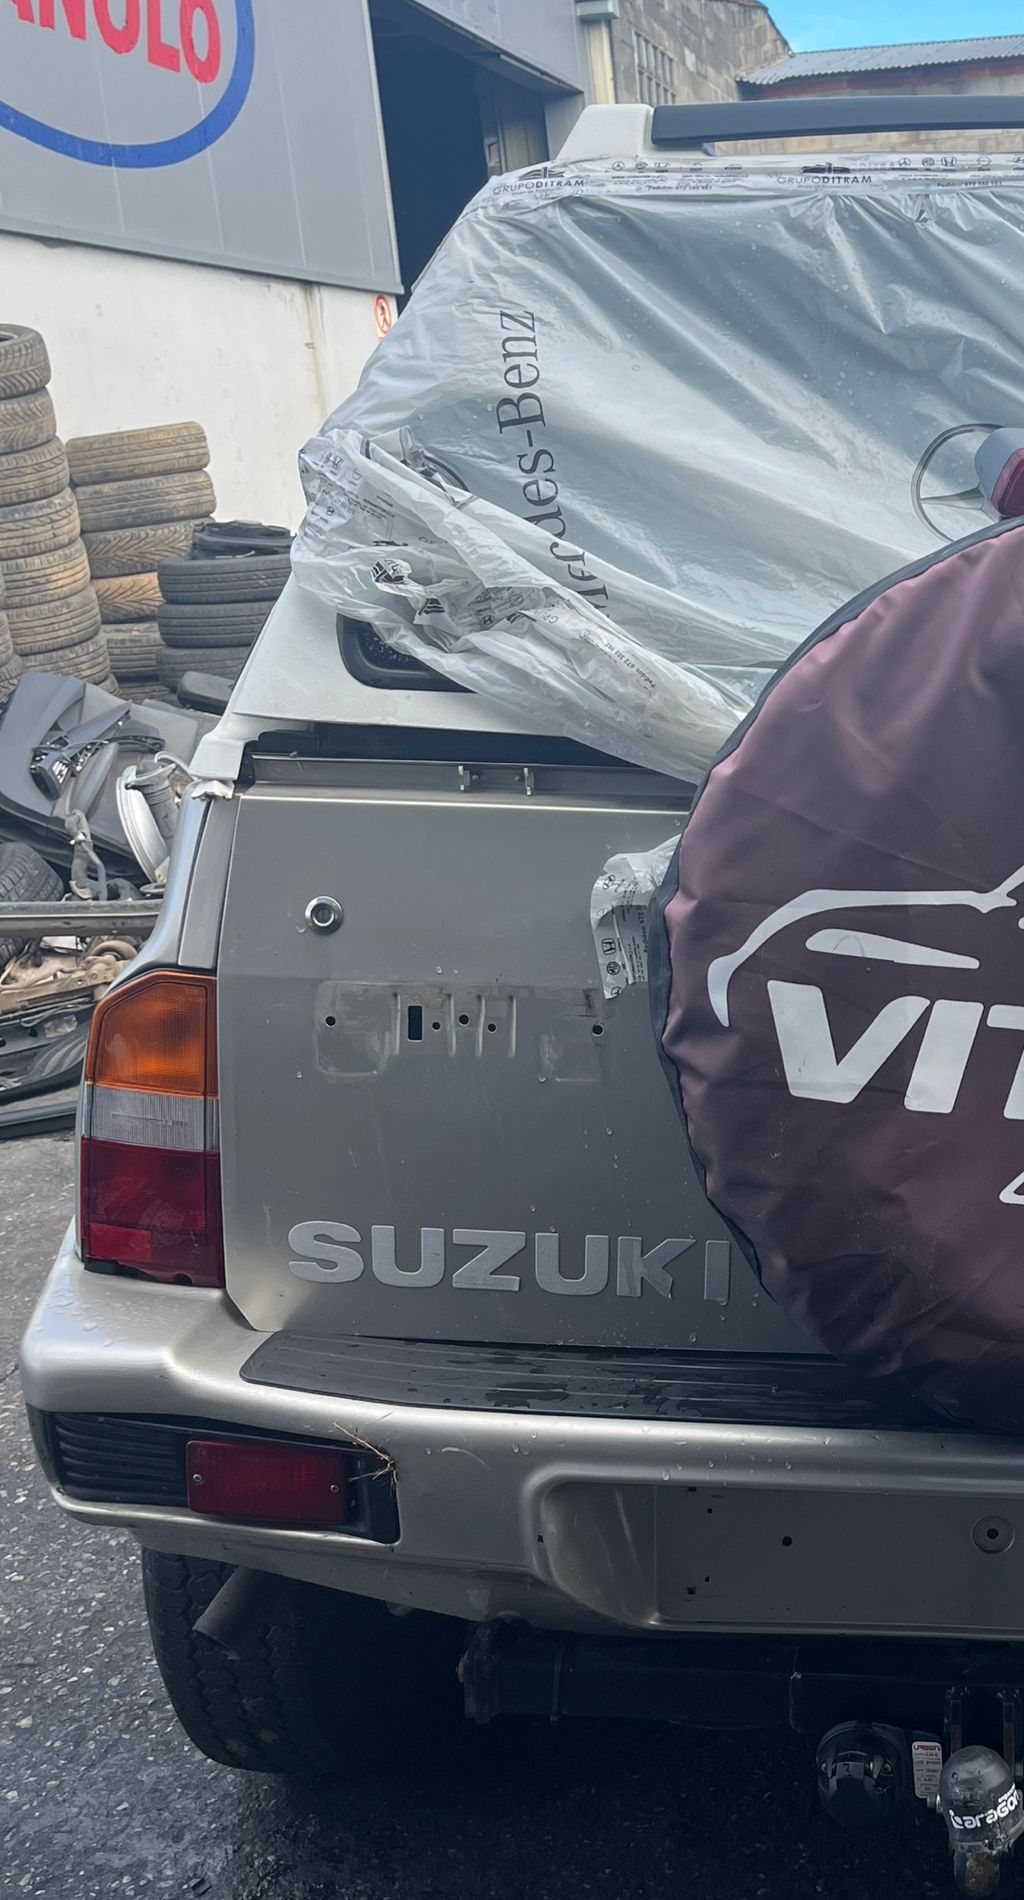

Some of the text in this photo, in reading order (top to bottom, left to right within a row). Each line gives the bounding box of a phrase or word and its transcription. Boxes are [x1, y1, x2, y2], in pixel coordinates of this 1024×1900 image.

[7, 0, 221, 83] OLO
[493, 180, 584, 195] GRUPODITRAM
[288, 1219, 731, 1301] SUZUKI
